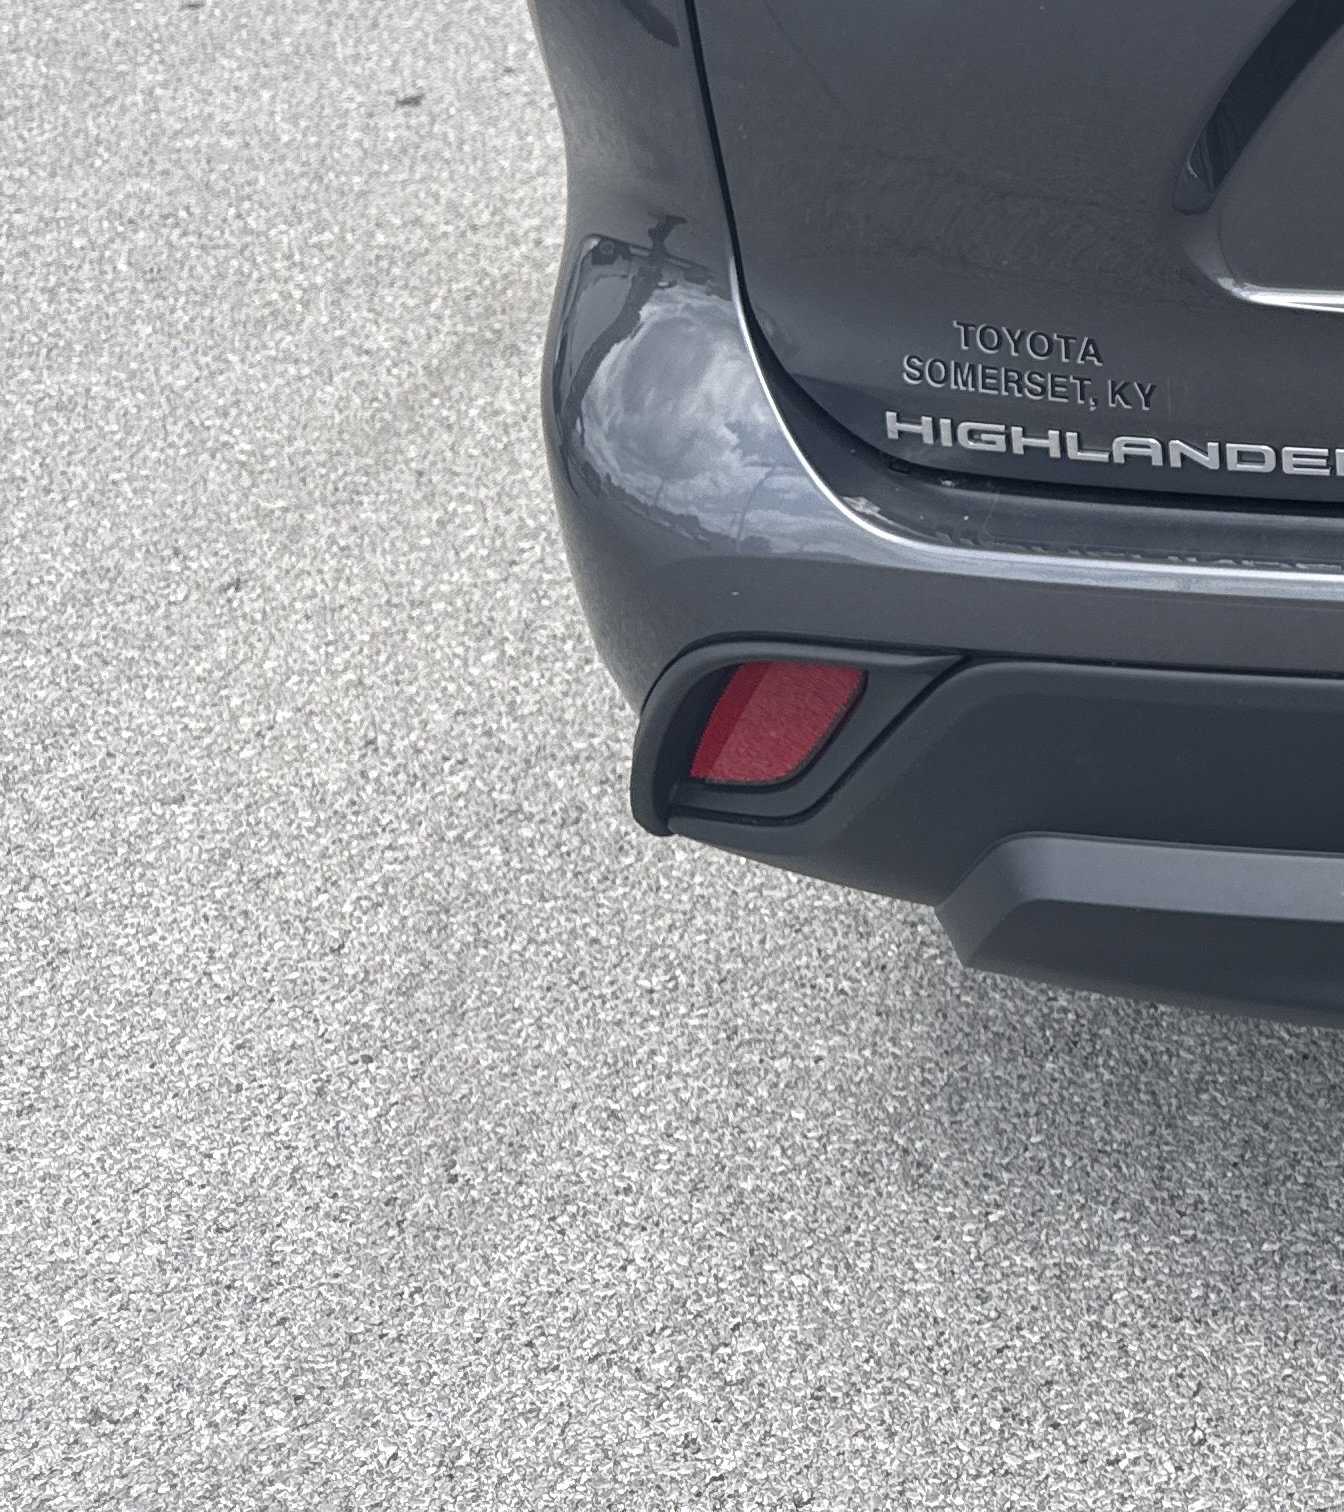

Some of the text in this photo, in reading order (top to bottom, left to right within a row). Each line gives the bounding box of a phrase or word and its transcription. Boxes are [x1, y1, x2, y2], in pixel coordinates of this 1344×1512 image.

[953, 320, 1103, 366] TOYOTA
[902, 354, 1157, 411] SOMERSET, KY
